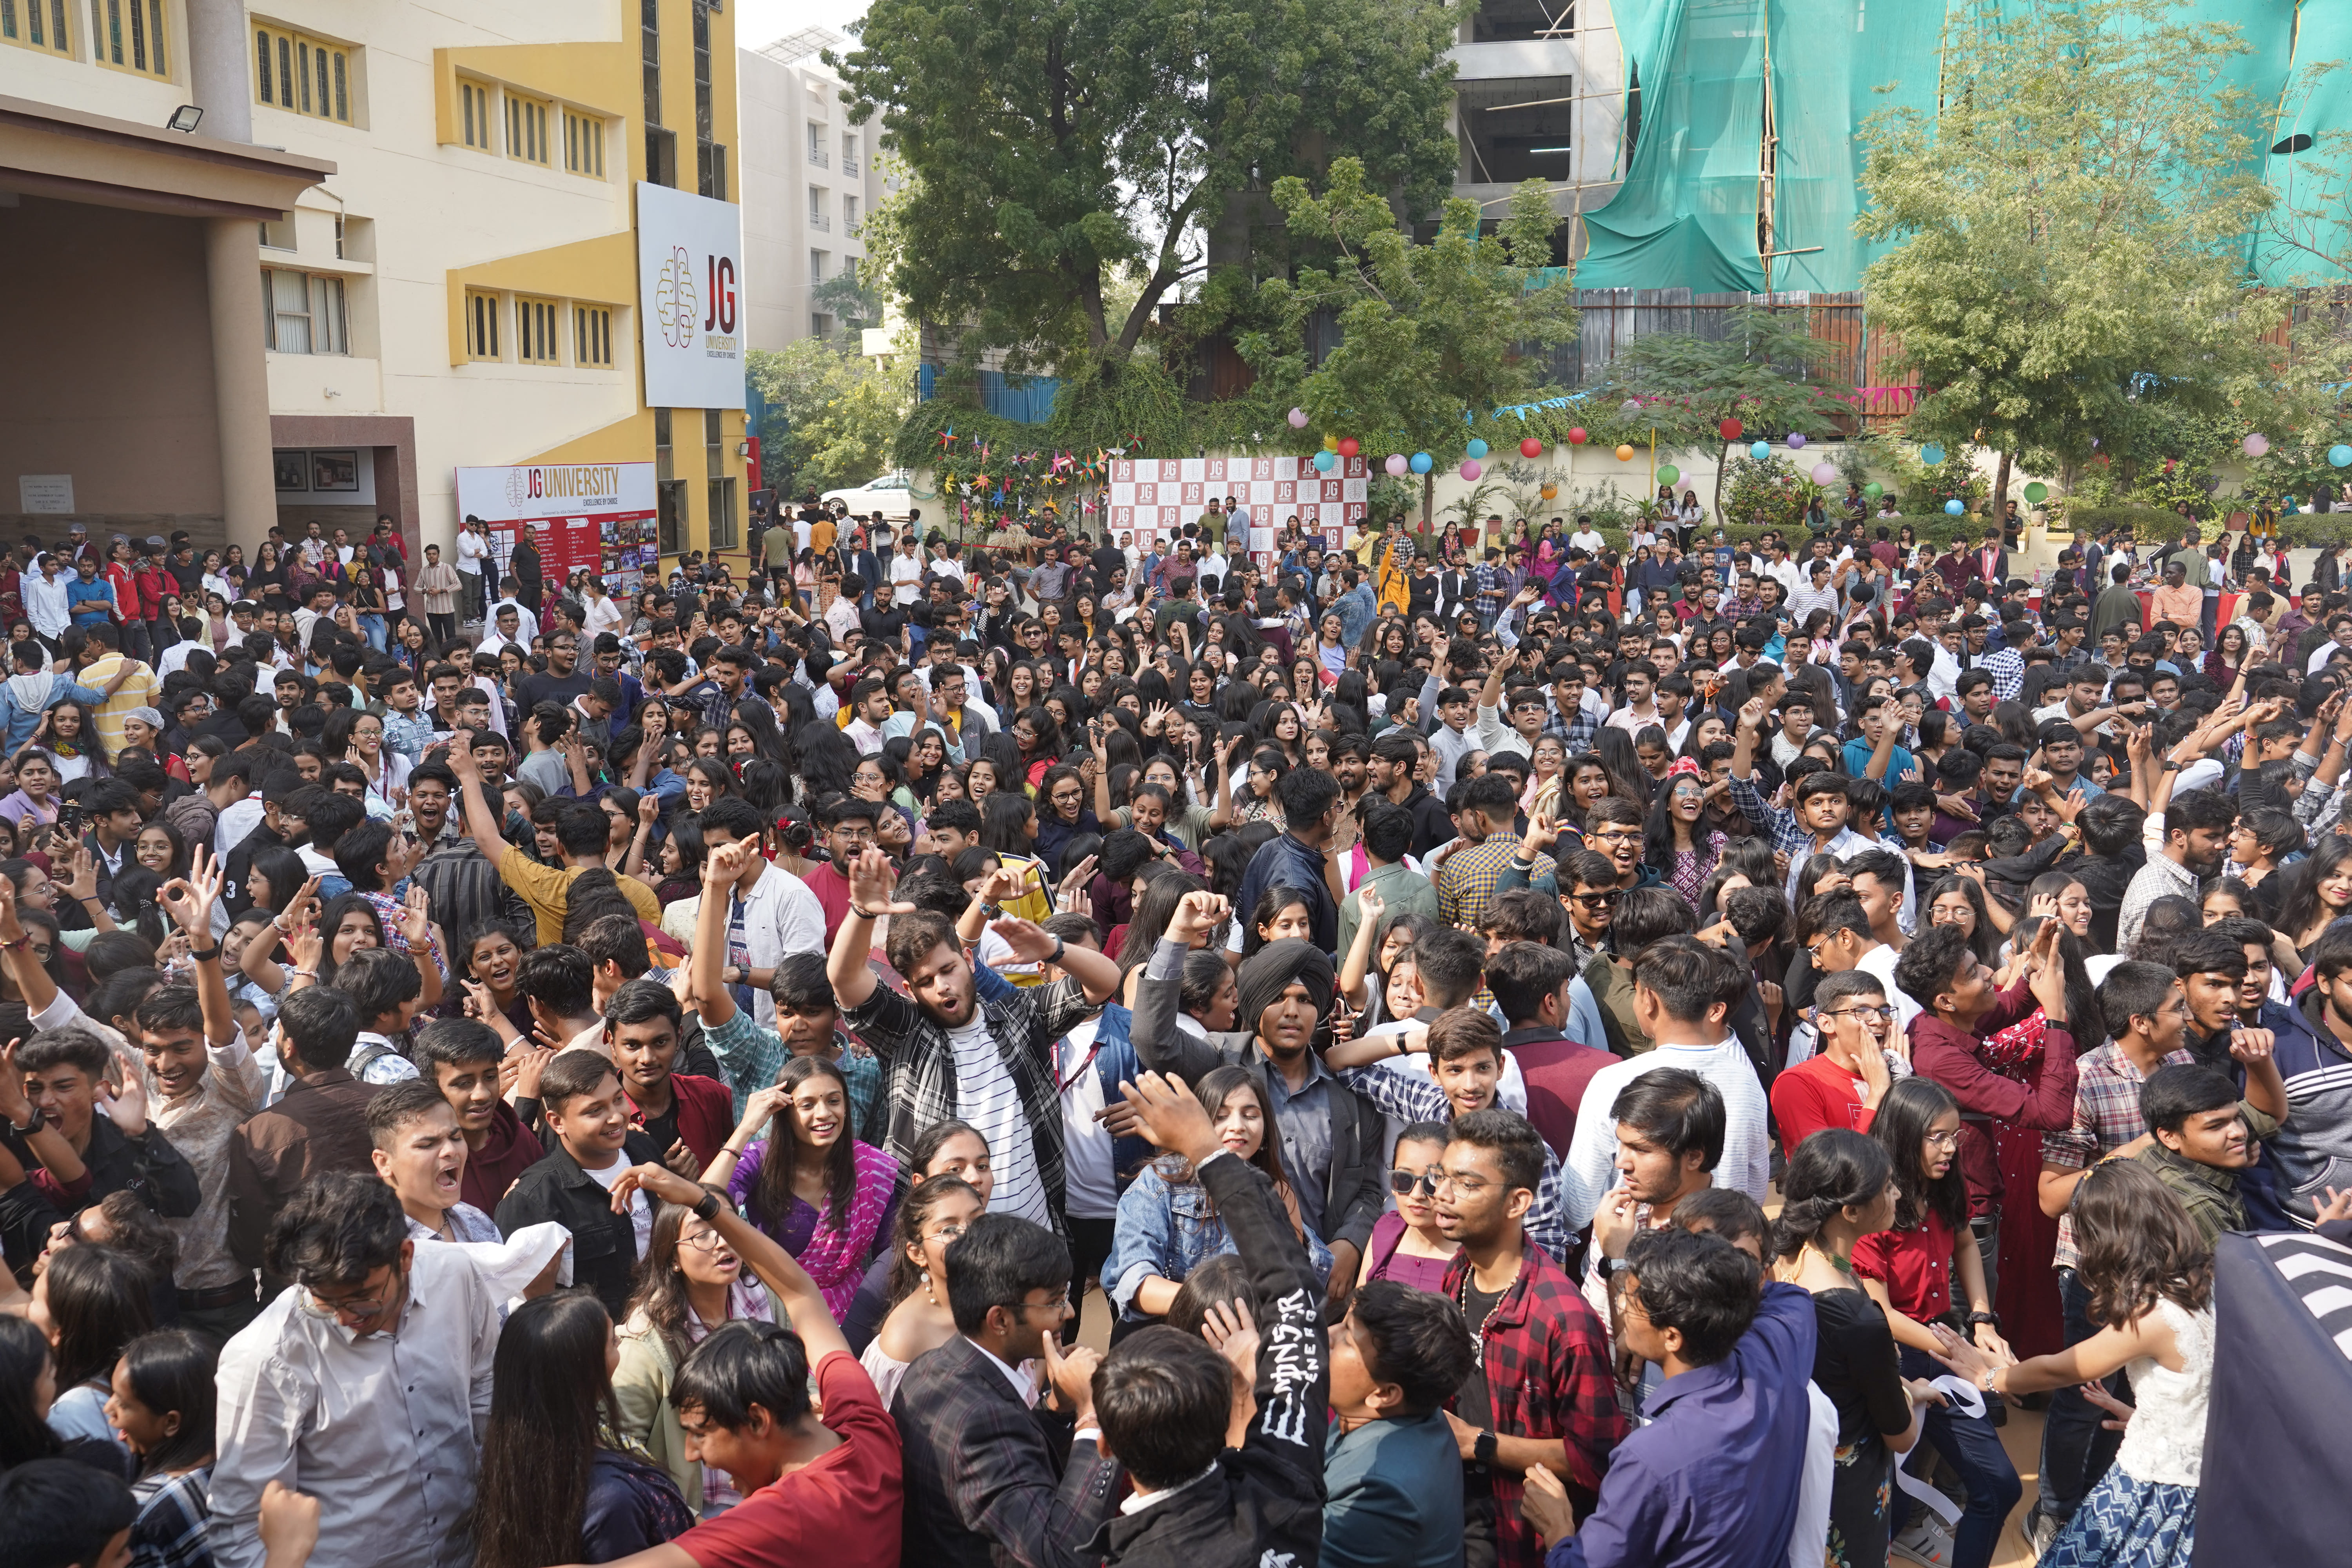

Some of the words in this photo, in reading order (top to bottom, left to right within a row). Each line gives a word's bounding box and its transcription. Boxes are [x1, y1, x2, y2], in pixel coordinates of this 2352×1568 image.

[705, 254, 735, 334] JG
[706, 334, 737, 351] UNIVERSITY
[1117, 462, 1130, 477] JG
[1163, 461, 1176, 476] JG
[1210, 461, 1223, 475] JG
[1256, 460, 1269, 475] JG
[1349, 457, 1361, 472] JG
[528, 469, 542, 499] JG
[544, 467, 619, 498] UNIVERSITY
[1232, 483, 1245, 498] JG
[1278, 483, 1292, 497] JG
[1325, 481, 1338, 497] JG
[1140, 485, 1152, 499] JG
[1186, 484, 1199, 499] JG
[1116, 508, 1129, 523] JG
[1163, 507, 1176, 522] JG
[1255, 506, 1268, 521] JG
[1302, 506, 1314, 521] JG
[1348, 505, 1361, 519] JG
[1139, 531, 1152, 546] JG
[226, 880, 236, 898] 3
